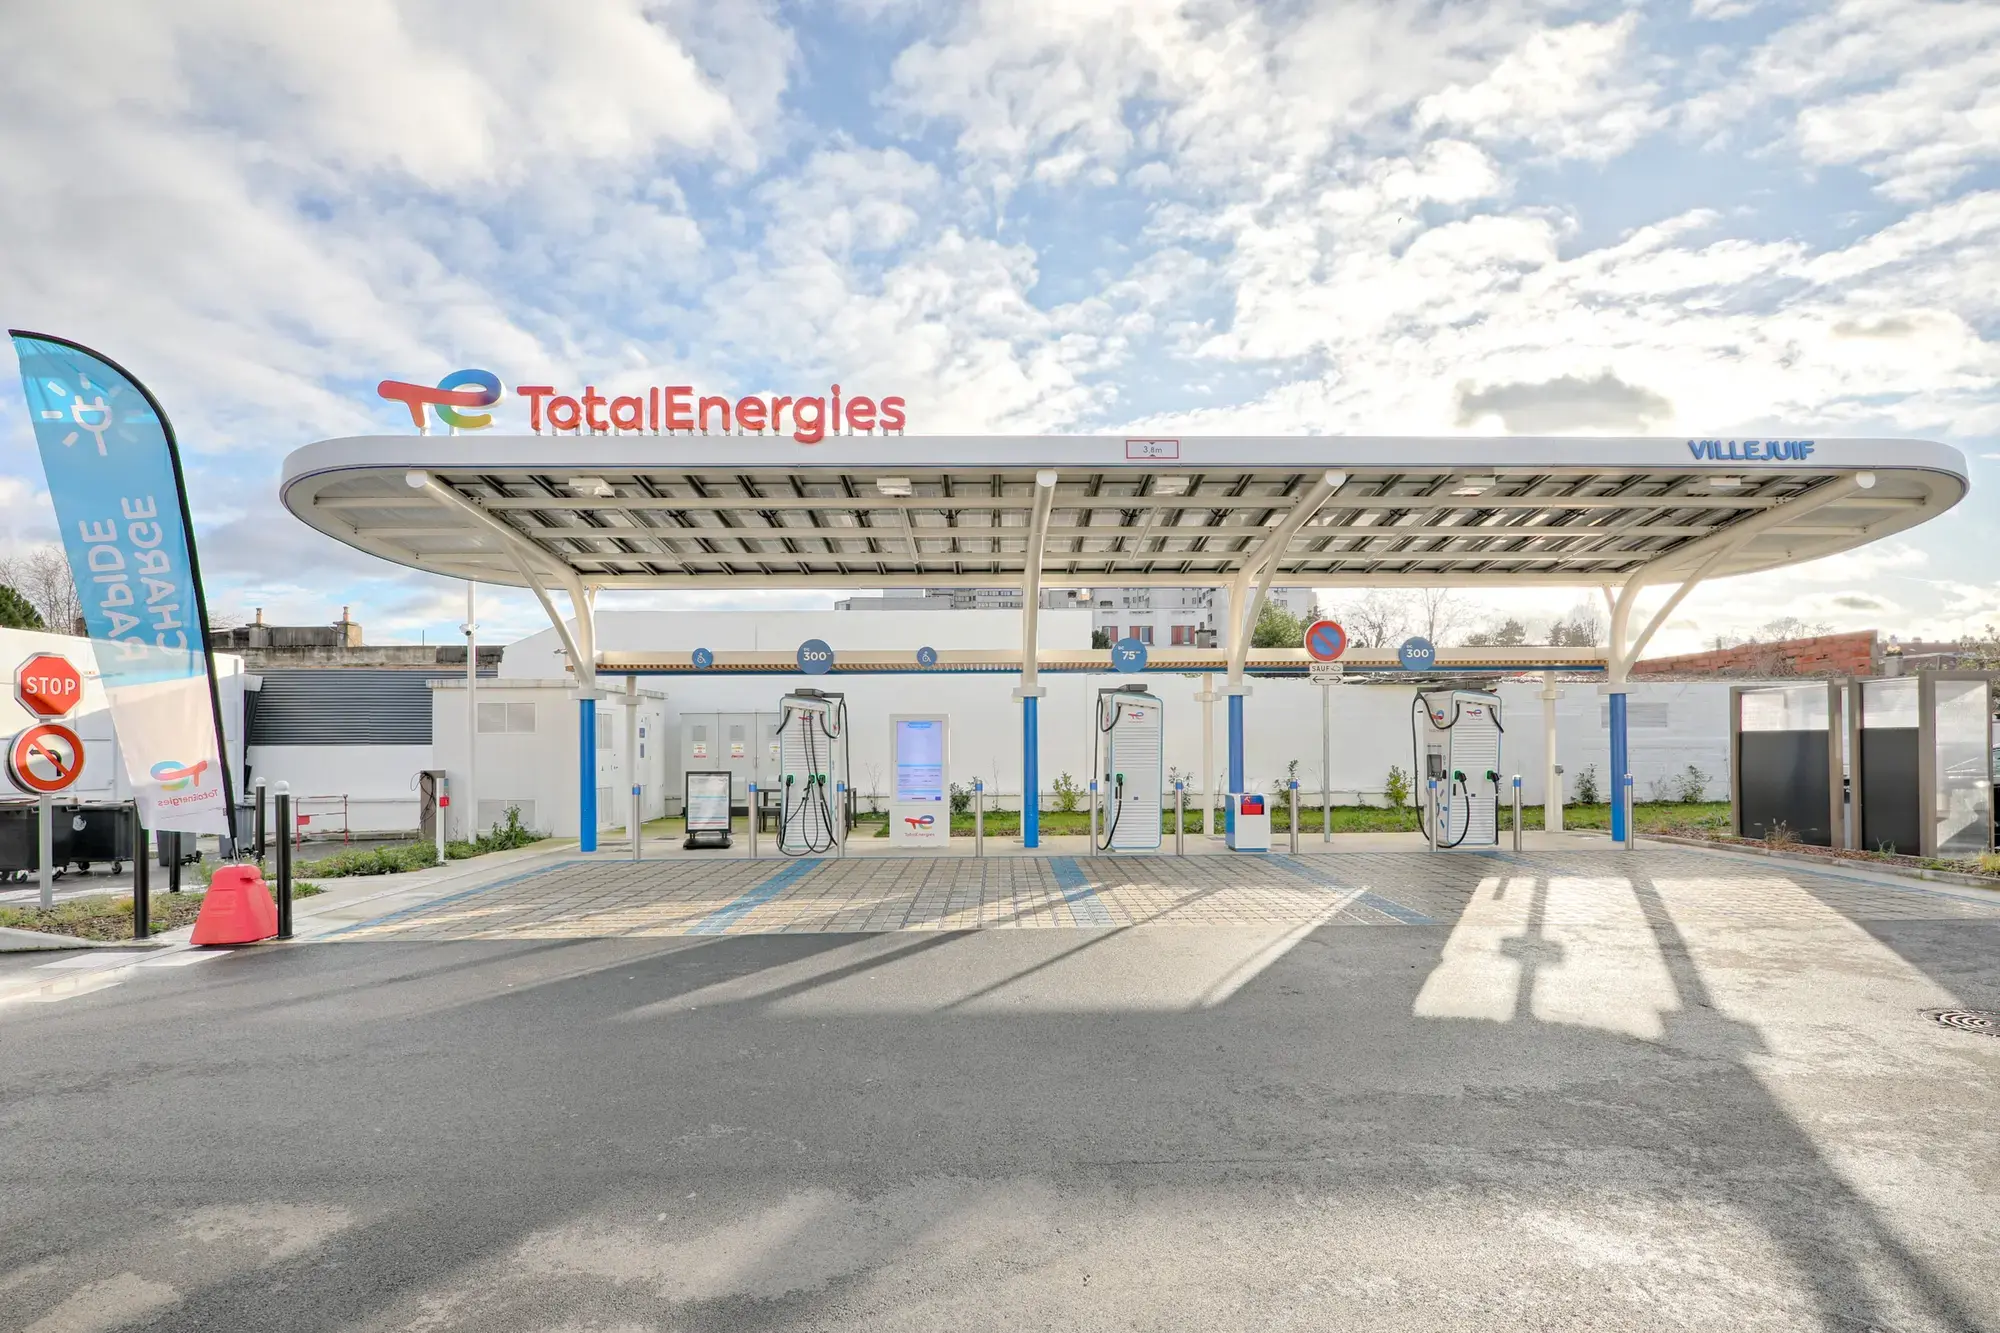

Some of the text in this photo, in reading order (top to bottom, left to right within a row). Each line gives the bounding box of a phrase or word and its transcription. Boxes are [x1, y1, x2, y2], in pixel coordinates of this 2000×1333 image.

[516, 383, 906, 443] TotalEnergies
[1688, 439, 1815, 461] VILLEJUIF
[803, 651, 827, 661] 300
[1122, 650, 1136, 660] 75
[1406, 648, 1429, 658] 300
[25, 676, 77, 695] STOP
